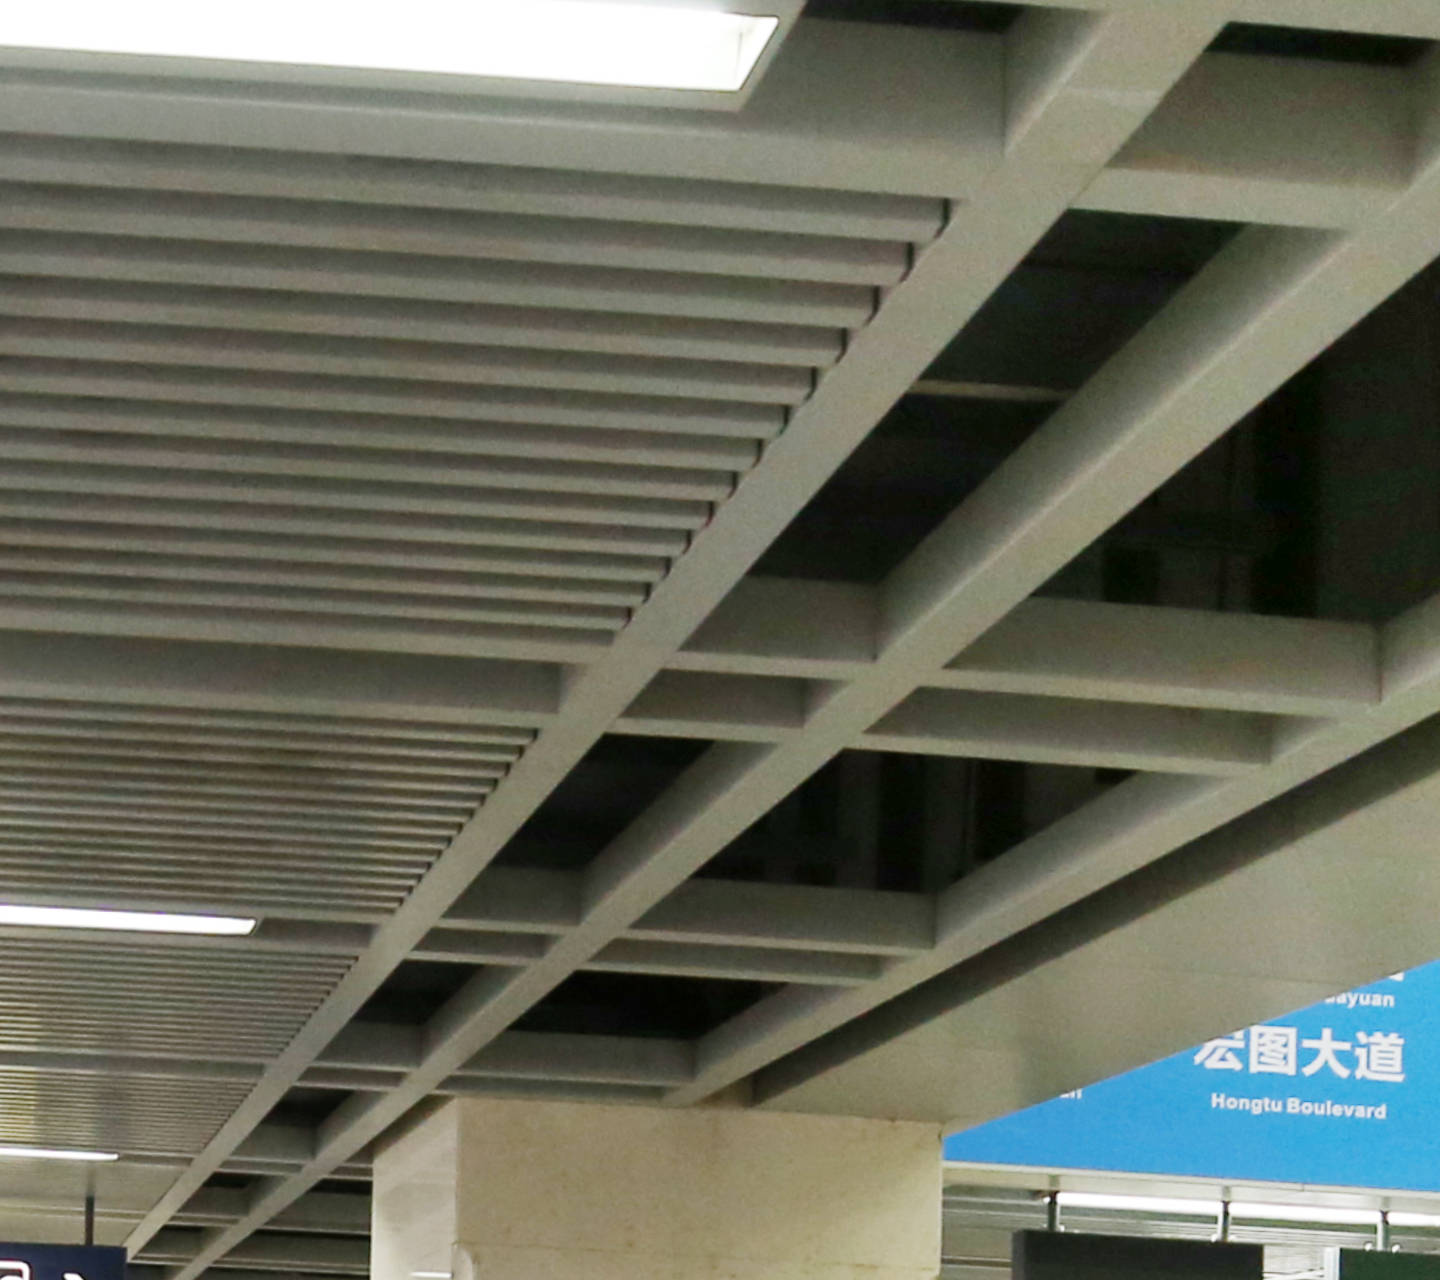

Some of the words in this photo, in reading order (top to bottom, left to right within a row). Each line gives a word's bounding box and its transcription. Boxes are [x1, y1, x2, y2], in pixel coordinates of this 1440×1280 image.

[1193, 1024, 1405, 1085] 宏图大道
[1211, 1091, 1283, 1118] Hongtu
[1287, 1094, 1386, 1122] Boulevard
